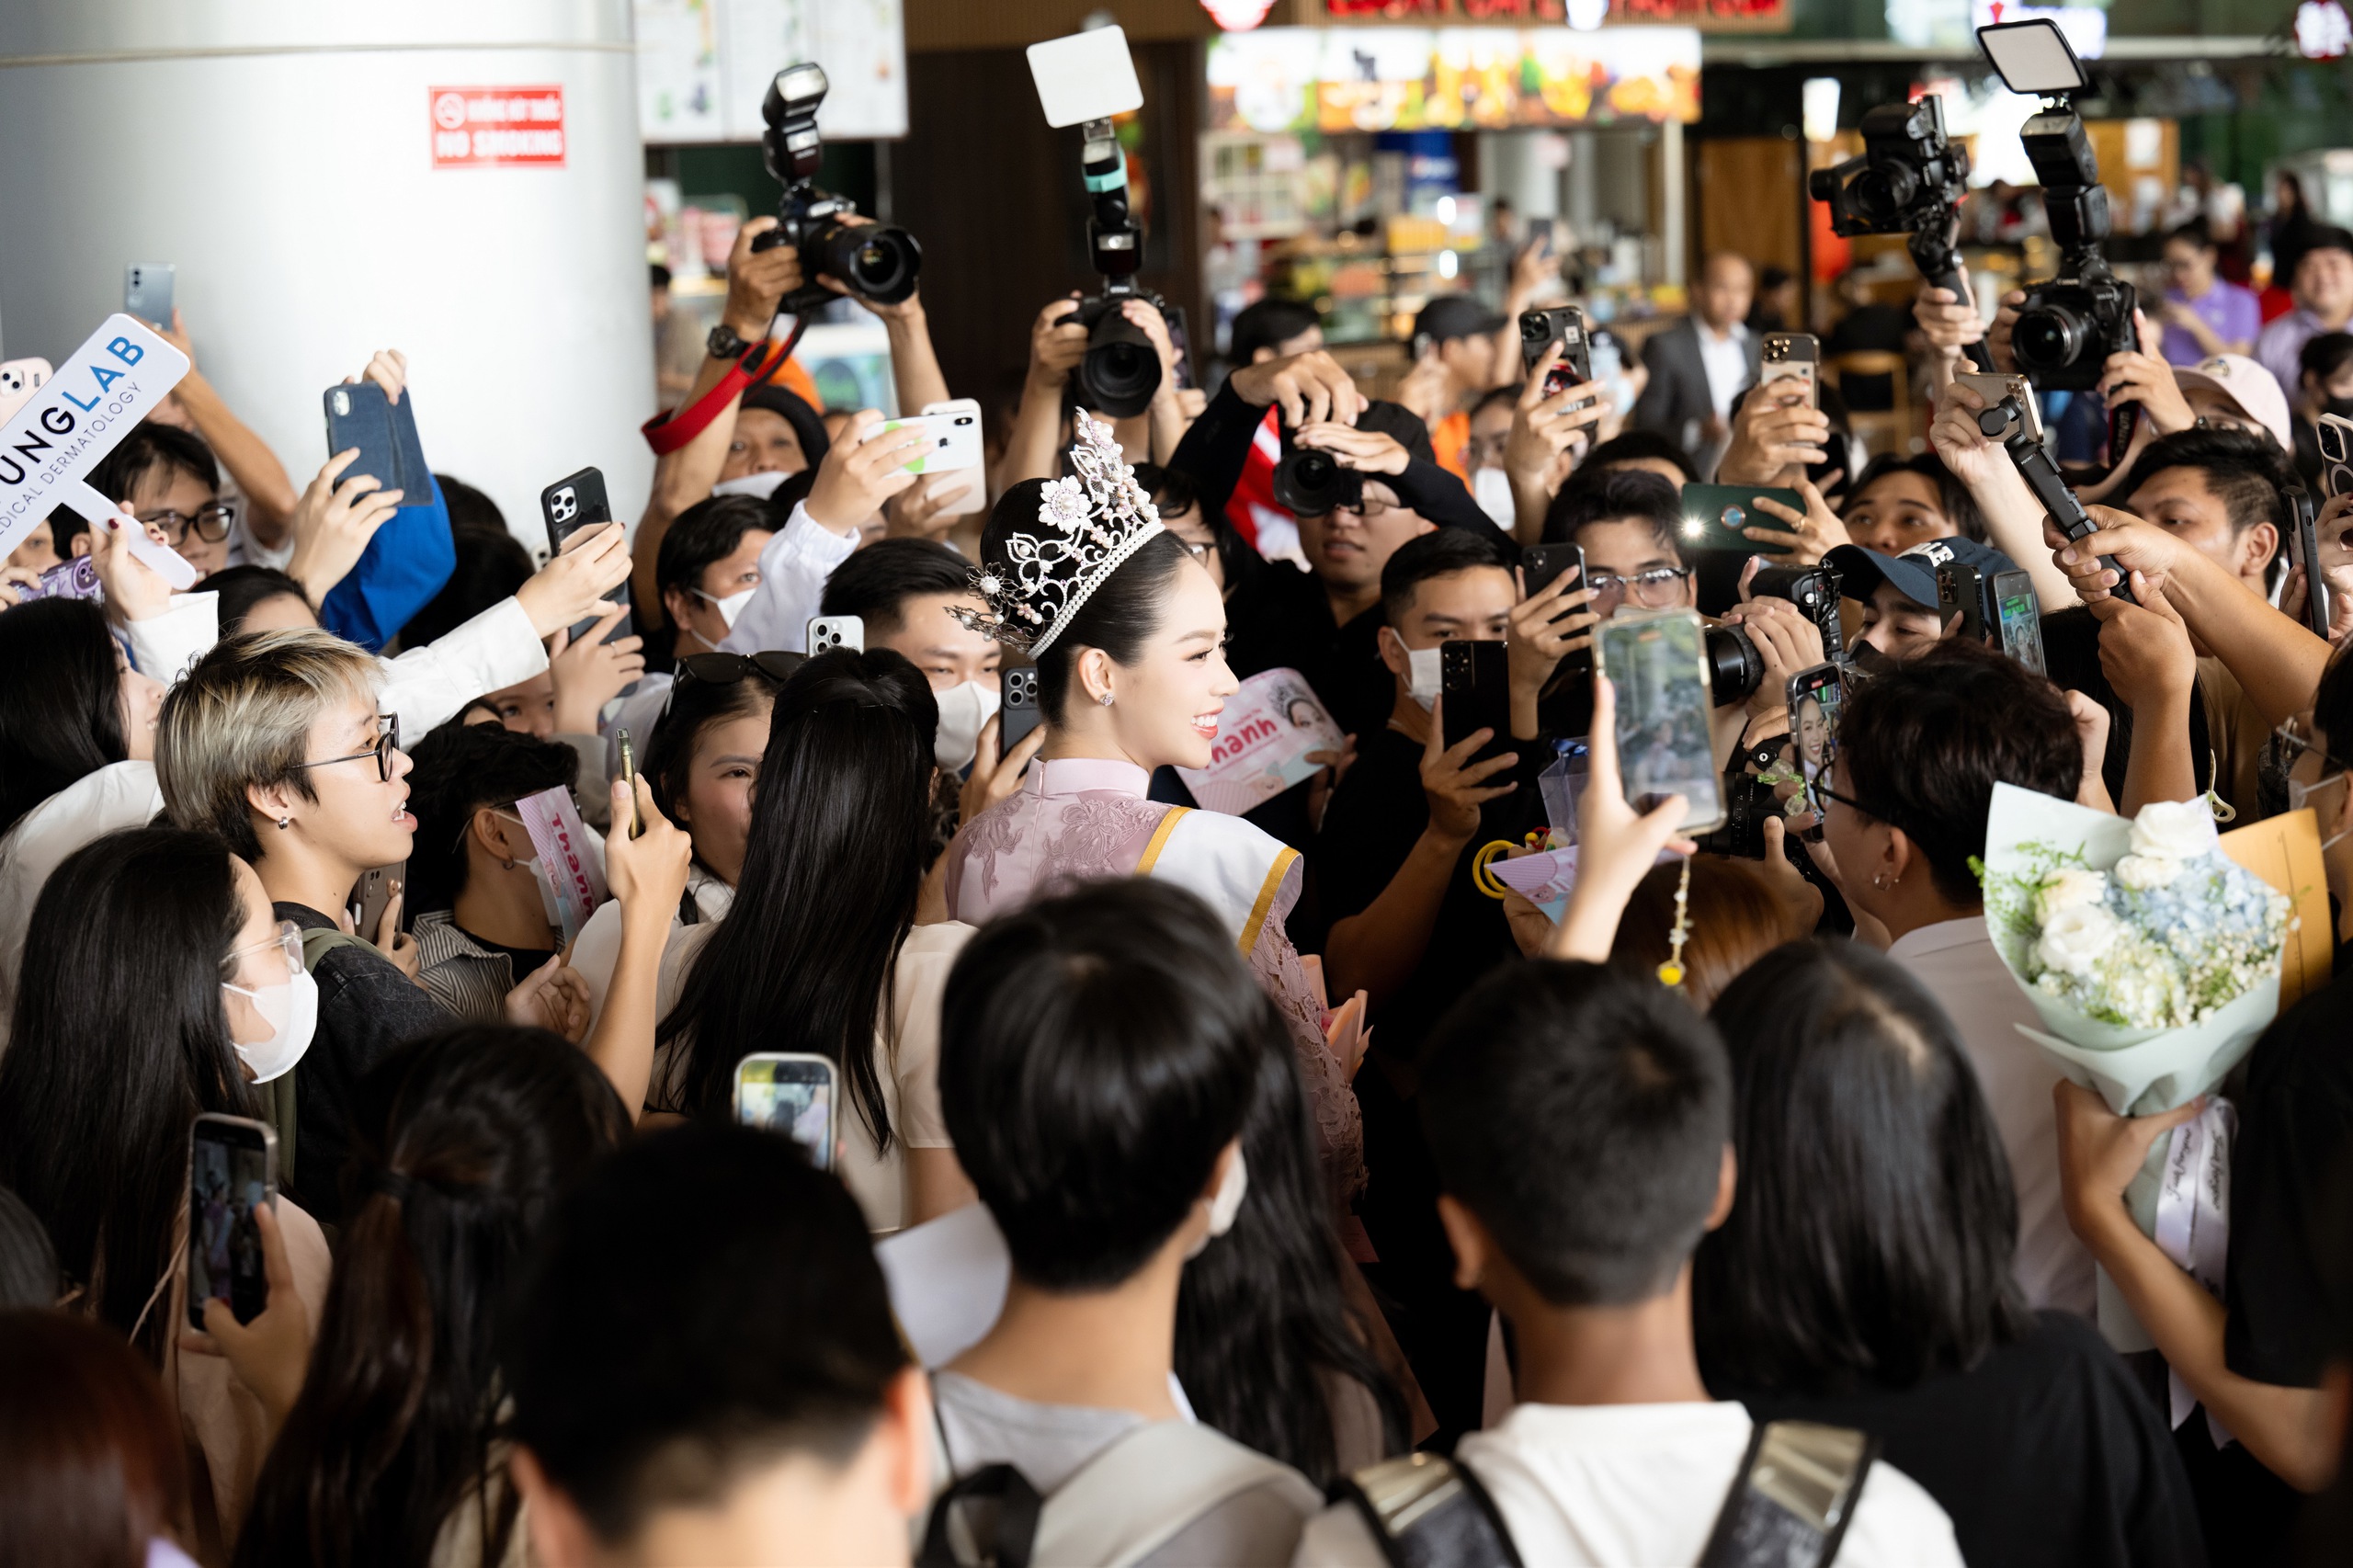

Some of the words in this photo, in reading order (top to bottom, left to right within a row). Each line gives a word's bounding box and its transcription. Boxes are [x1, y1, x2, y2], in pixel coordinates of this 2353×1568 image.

[437, 130, 471, 157] NO
[472, 130, 563, 157] SMOKING
[40, 381, 142, 485] DERMATOLOGY
